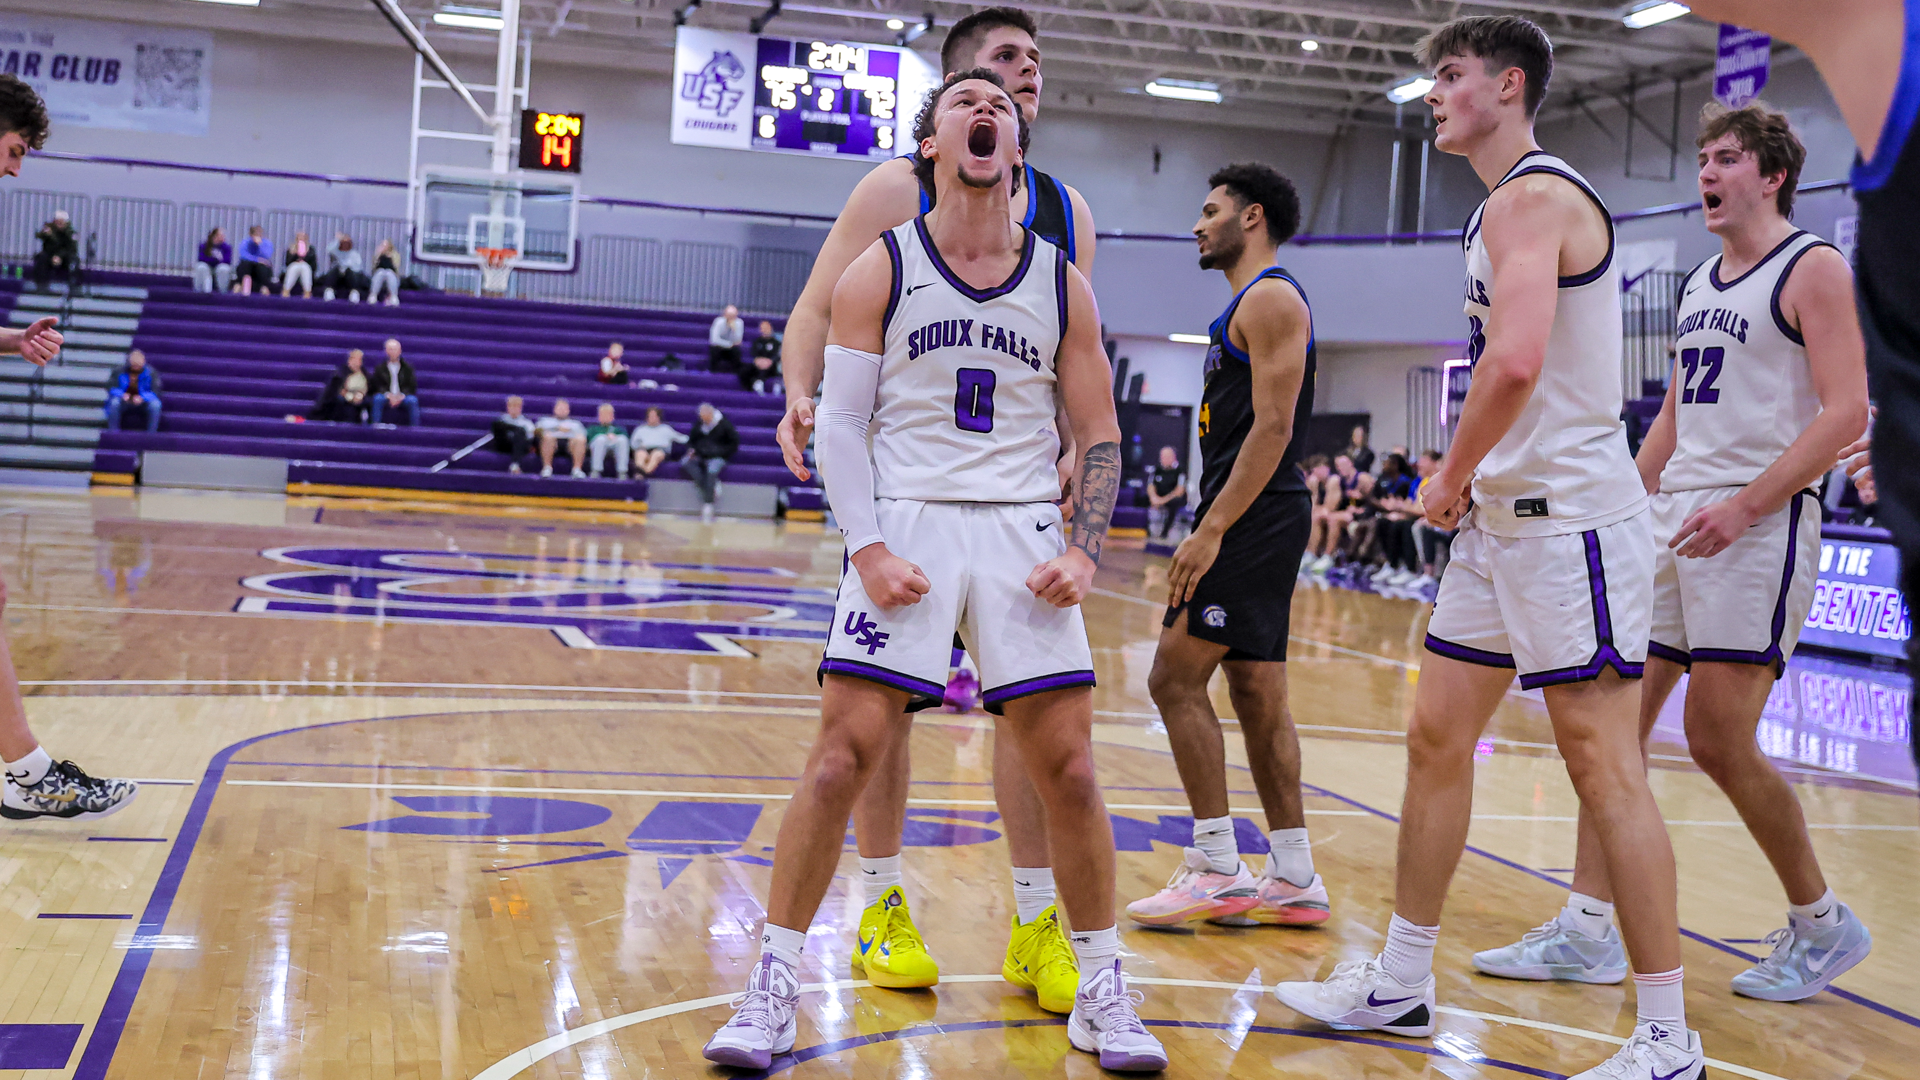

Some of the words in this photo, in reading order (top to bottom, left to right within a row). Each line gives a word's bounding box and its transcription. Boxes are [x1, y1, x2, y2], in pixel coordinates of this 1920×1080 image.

[0, 50, 42, 77] AR
[51, 53, 122, 86] CLUB
[808, 41, 865, 72] 2:04
[681, 72, 745, 117] USF
[764, 80, 796, 110] 75
[818, 88, 835, 111] 2
[864, 90, 896, 119] 72
[534, 112, 581, 137] 2:04
[759, 115, 776, 138] 6
[877, 126, 893, 149] 5
[541, 135, 572, 168] 14
[1709, 308, 1749, 344] FALLS
[908, 319, 974, 361] SIOUX
[981, 323, 1041, 372] FALLS
[1681, 346, 1725, 404] 22
[954, 367, 996, 433] 0
[1836, 546, 1873, 576] THE
[844, 611, 890, 656] USF
